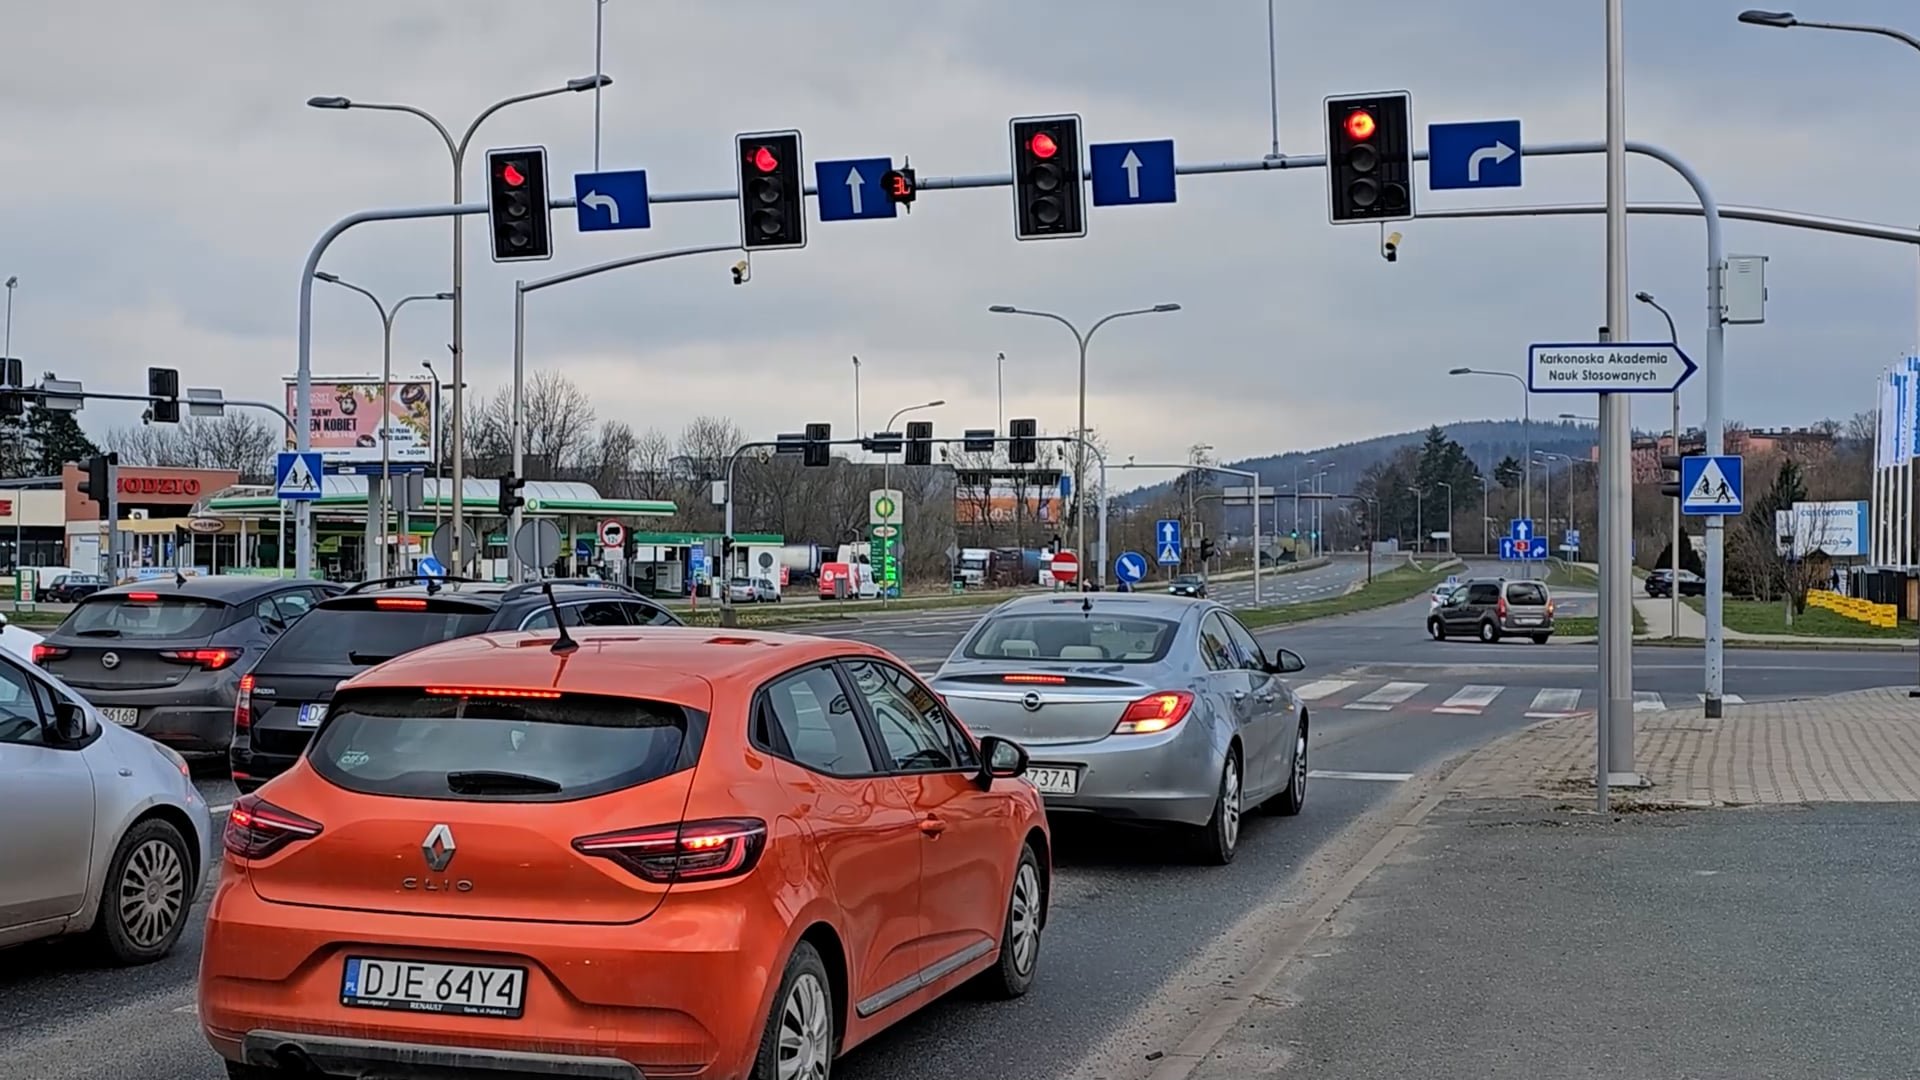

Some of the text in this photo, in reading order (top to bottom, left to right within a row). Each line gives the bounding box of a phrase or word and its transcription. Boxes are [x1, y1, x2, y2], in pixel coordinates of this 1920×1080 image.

[1539, 352, 1668, 365] Karkonoska Akademia
[1549, 369, 1657, 383] Nauk Stosowanych
[323, 418, 357, 431] KOBIET
[1024, 769, 1071, 788] 737A
[402, 877, 473, 892] CLIO
[345, 982, 357, 992] PL
[364, 963, 515, 1006] DJE 64Y4
[409, 1002, 443, 1011] RENAULT
